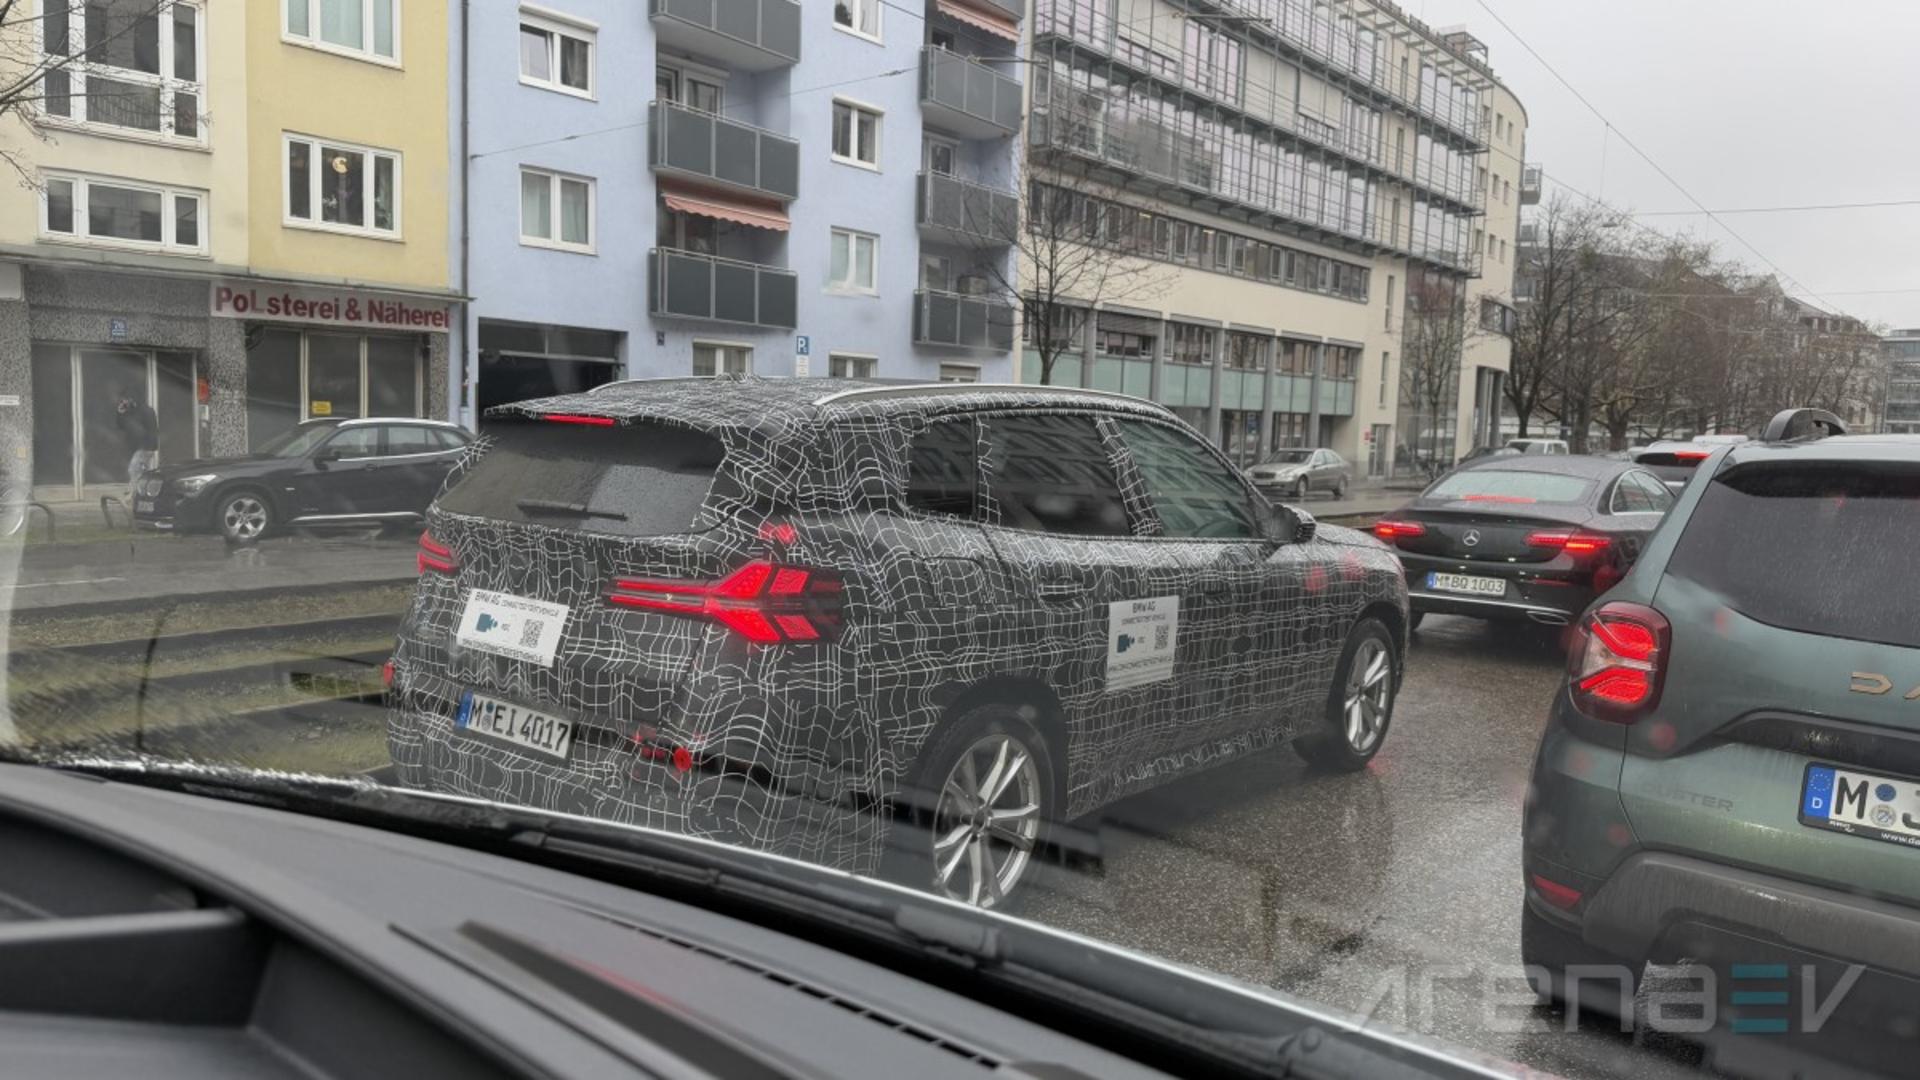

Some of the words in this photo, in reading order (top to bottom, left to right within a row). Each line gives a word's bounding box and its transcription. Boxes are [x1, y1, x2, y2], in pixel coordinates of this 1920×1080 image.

[345, 297, 362, 321] &
[367, 299, 449, 329] Näherei
[1434, 575, 1444, 587] M
[1470, 578, 1504, 593] 1003
[468, 699, 484, 728] M
[492, 704, 518, 738] EI
[520, 713, 569, 753] 4017
[1640, 781, 1734, 813] DUSTER
[1811, 796, 1823, 809] D
[1834, 775, 1870, 820] M
